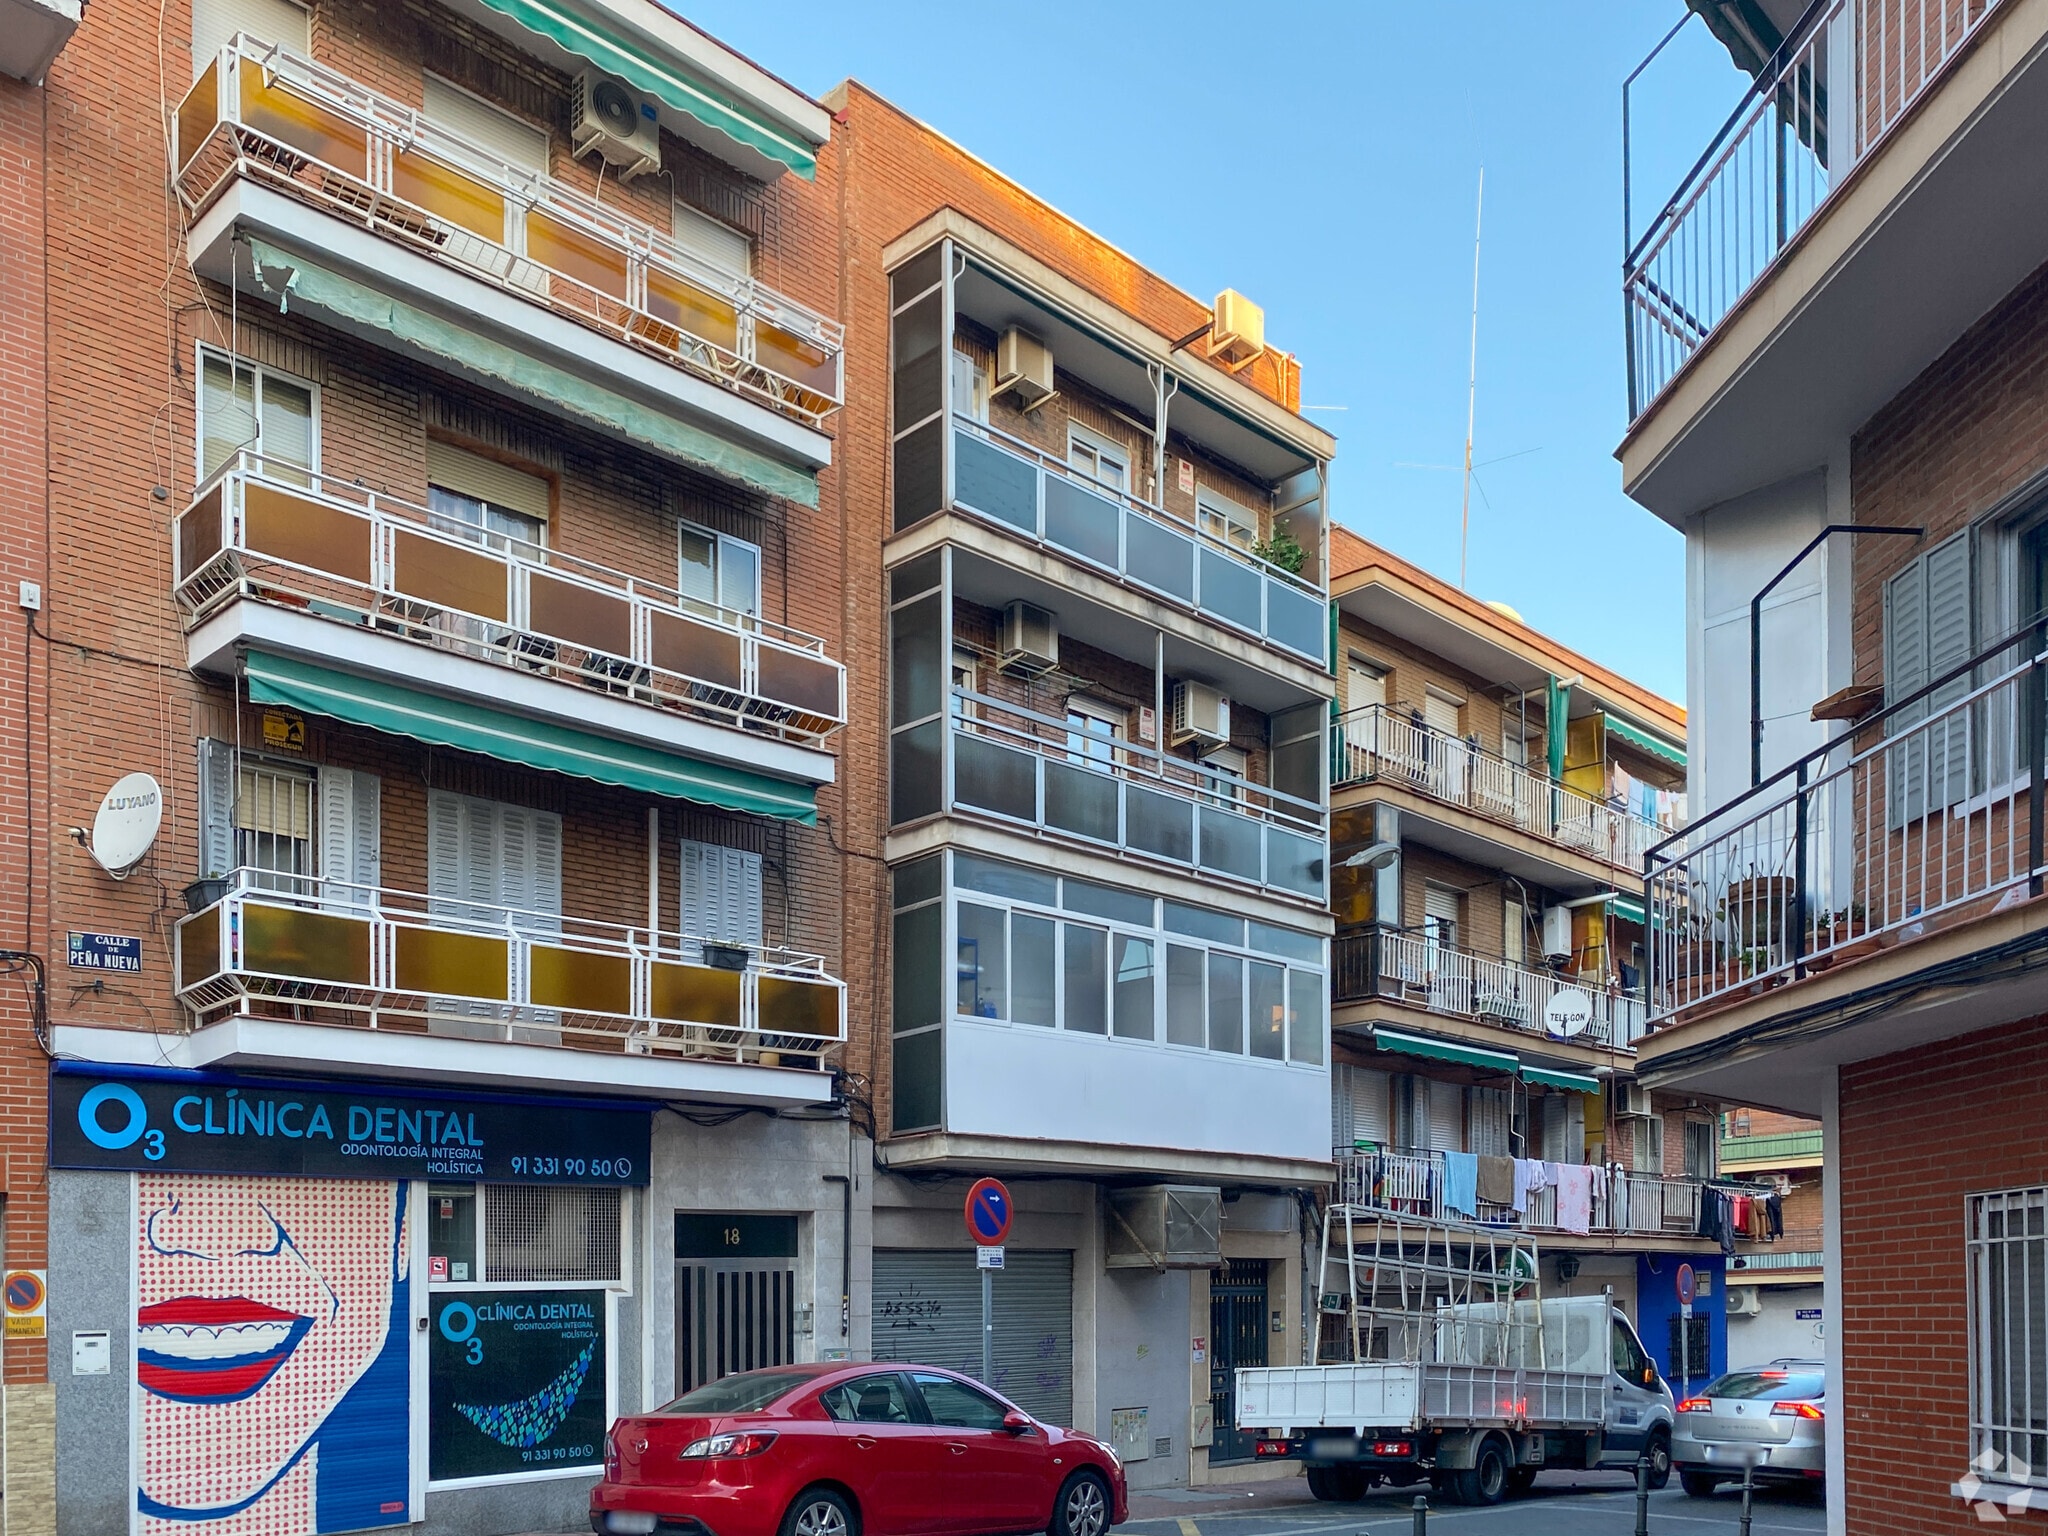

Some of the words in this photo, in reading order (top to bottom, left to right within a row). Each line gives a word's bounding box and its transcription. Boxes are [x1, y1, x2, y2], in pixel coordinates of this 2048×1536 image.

[108, 792, 156, 810] LUYANO
[95, 936, 130, 947] CALLE
[70, 950, 100, 967] PEÑA
[104, 954, 139, 970] NUEVA
[173, 1088, 334, 1140] CLÍNICA
[348, 1106, 483, 1146] DENTAL
[340, 1143, 429, 1158] ODONTOLOGÍA
[431, 1147, 484, 1161] INTEGRAL
[427, 1160, 484, 1176] HOLÍSTICA
[510, 1156, 528, 1175] 91
[532, 1157, 560, 1176] 331
[564, 1158, 586, 1177] 90
[590, 1159, 612, 1177] 50
[724, 1227, 741, 1245] 18
[476, 1301, 536, 1321] CLÍNICA
[541, 1304, 594, 1319] DENTAL
[514, 1321, 563, 1330] ODONTOLOGÍA
[564, 1321, 594, 1329] INTEGRAL
[561, 1329, 594, 1339] HOLÍSTICA
[522, 1451, 531, 1461] 91
[535, 1450, 550, 1460] 331
[553, 1448, 565, 1458] 90
[569, 1447, 581, 1457] 50
